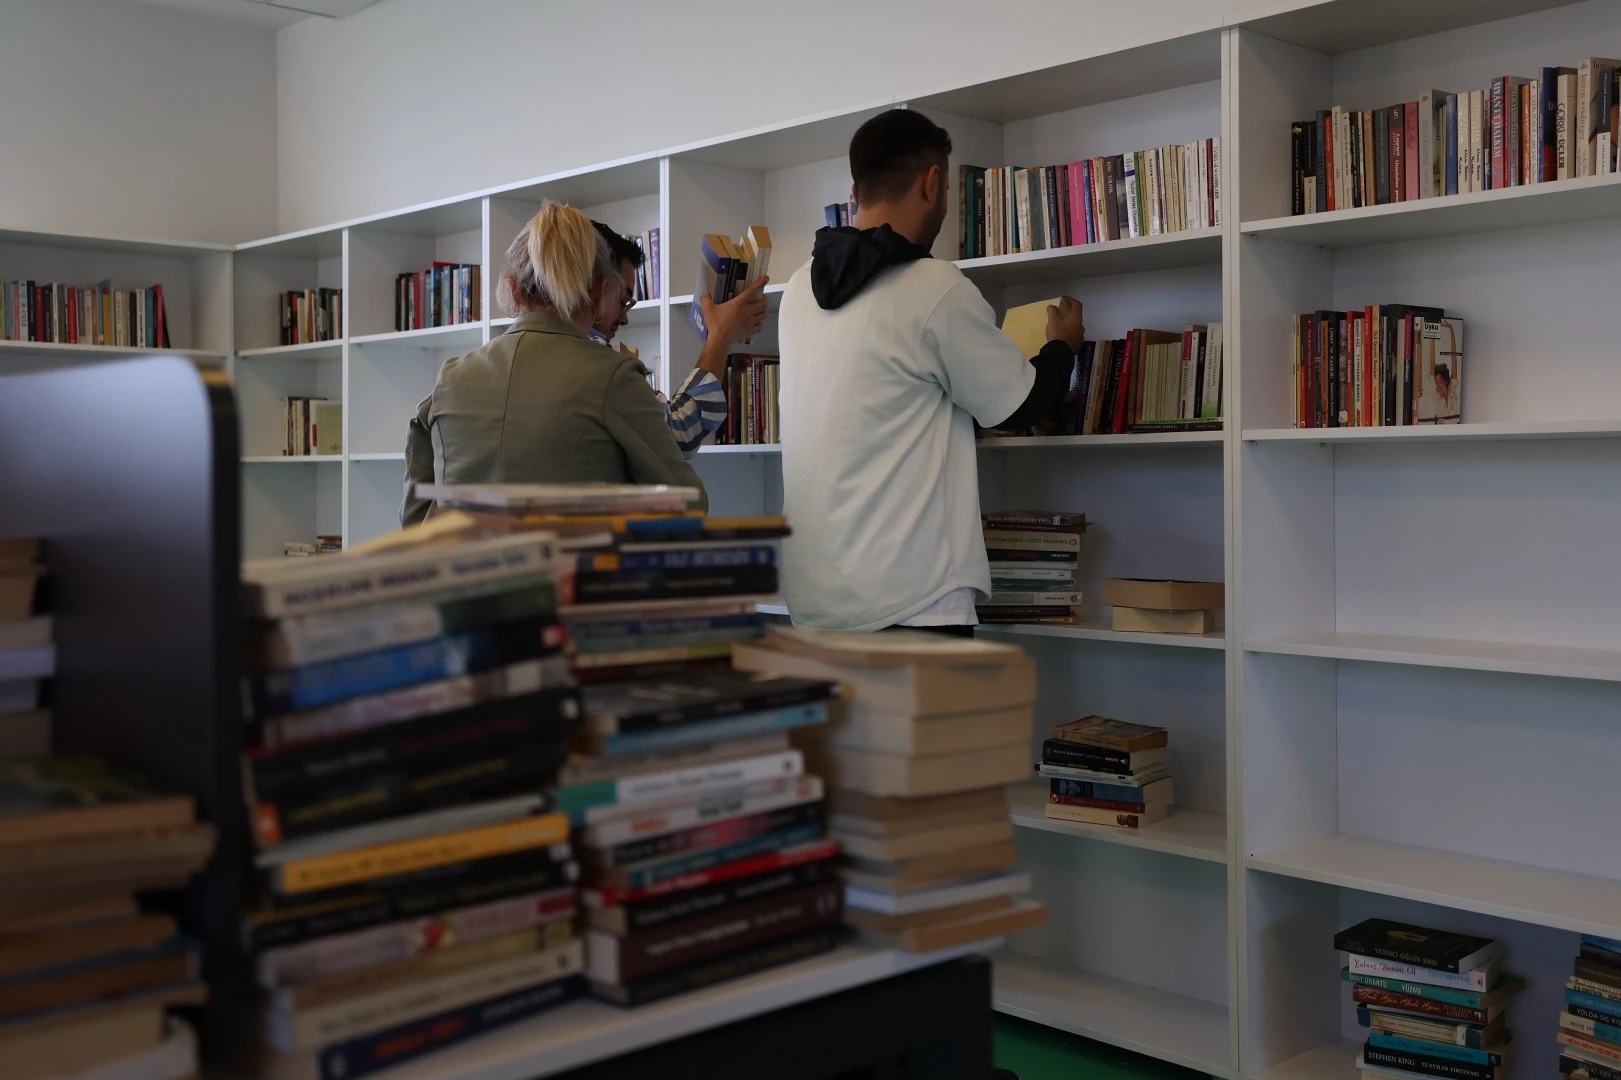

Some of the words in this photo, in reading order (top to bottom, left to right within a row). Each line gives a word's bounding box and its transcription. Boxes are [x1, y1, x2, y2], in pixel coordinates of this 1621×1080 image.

[1492, 82, 1502, 108] UYAN
[1580, 74, 1588, 99] lauren
[1493, 109, 1502, 121] EY
[1578, 100, 1588, 141] weisberger
[1492, 122, 1502, 159] HALKIM
[1557, 139, 1566, 169] ÜÇLER
[1343, 944, 1365, 953] COOPER
[1375, 947, 1398, 958] YEDİNCİ
[1400, 952, 1421, 963] OĞLUN
[1423, 957, 1438, 966] SIRRI
[1353, 958, 1377, 970] Yalnız
[1380, 963, 1405, 974] Benim
[1407, 967, 1416, 975] Ol
[1365, 976, 1387, 988] URARTU
[1402, 984, 1422, 995] YÜZME
[1359, 991, 1377, 1001] Yedi
[1381, 994, 1397, 1004] Gün
[1400, 998, 1419, 1008] Yedi
[1422, 1001, 1440, 1011] Gece
[1576, 1008, 1598, 1019] YOLDA
[1601, 1014, 1610, 1024] ÜÇ
[1611, 1017, 1621, 1027] KİŞ
[1368, 1052, 1396, 1063] STEPHEN
[1398, 1056, 1415, 1066] KING
[1421, 1061, 1449, 1072] YÜZYILIN
[1450, 1066, 1480, 1077] FIRTINASI
